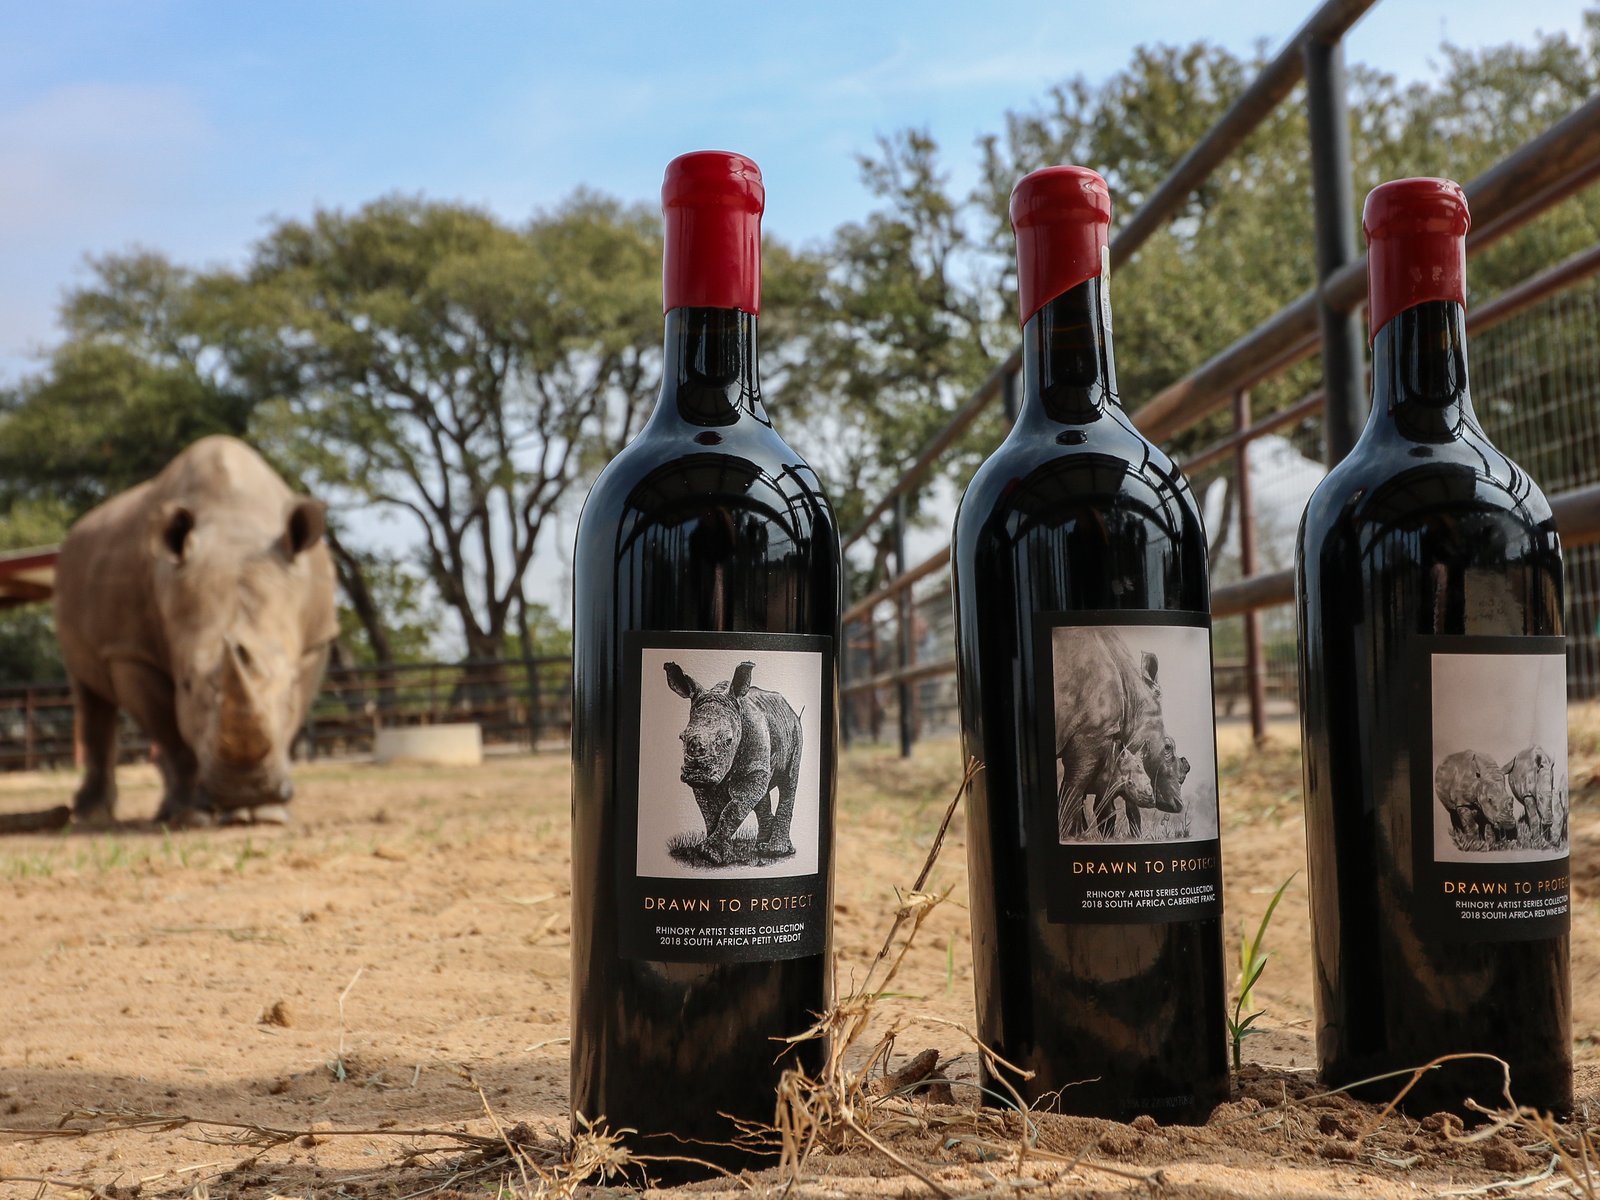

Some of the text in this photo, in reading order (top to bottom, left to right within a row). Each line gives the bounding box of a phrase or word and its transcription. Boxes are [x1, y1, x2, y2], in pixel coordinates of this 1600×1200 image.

[1073, 862, 1137, 874] DRAWN
[1145, 860, 1165, 873] TO
[1086, 884, 1214, 899] RHINORY ARTIST SERIES COLLECTION
[1444, 876, 1569, 894] DRAWN TO PROTEC
[644, 894, 813, 912] DRAWN TO PROTECT
[1081, 893, 1216, 909] 2018 SOUTH AFRICA CABERNET FRANC
[1455, 900, 1495, 909] RHINORY
[1497, 900, 1521, 909] ARTIST
[1523, 899, 1543, 908] SERIES
[1461, 911, 1481, 919] 2018
[1481, 911, 1507, 920] SOUTH
[1508, 910, 1534, 919] AFRICA
[1534, 909, 1545, 918] RED
[1546, 907, 1558, 916] WINE
[655, 922, 805, 936] RHINORY ARTIST SERIES COLLECTION
[660, 932, 802, 947] 2018 SOUTH AFRICA PETIT VERDOT
